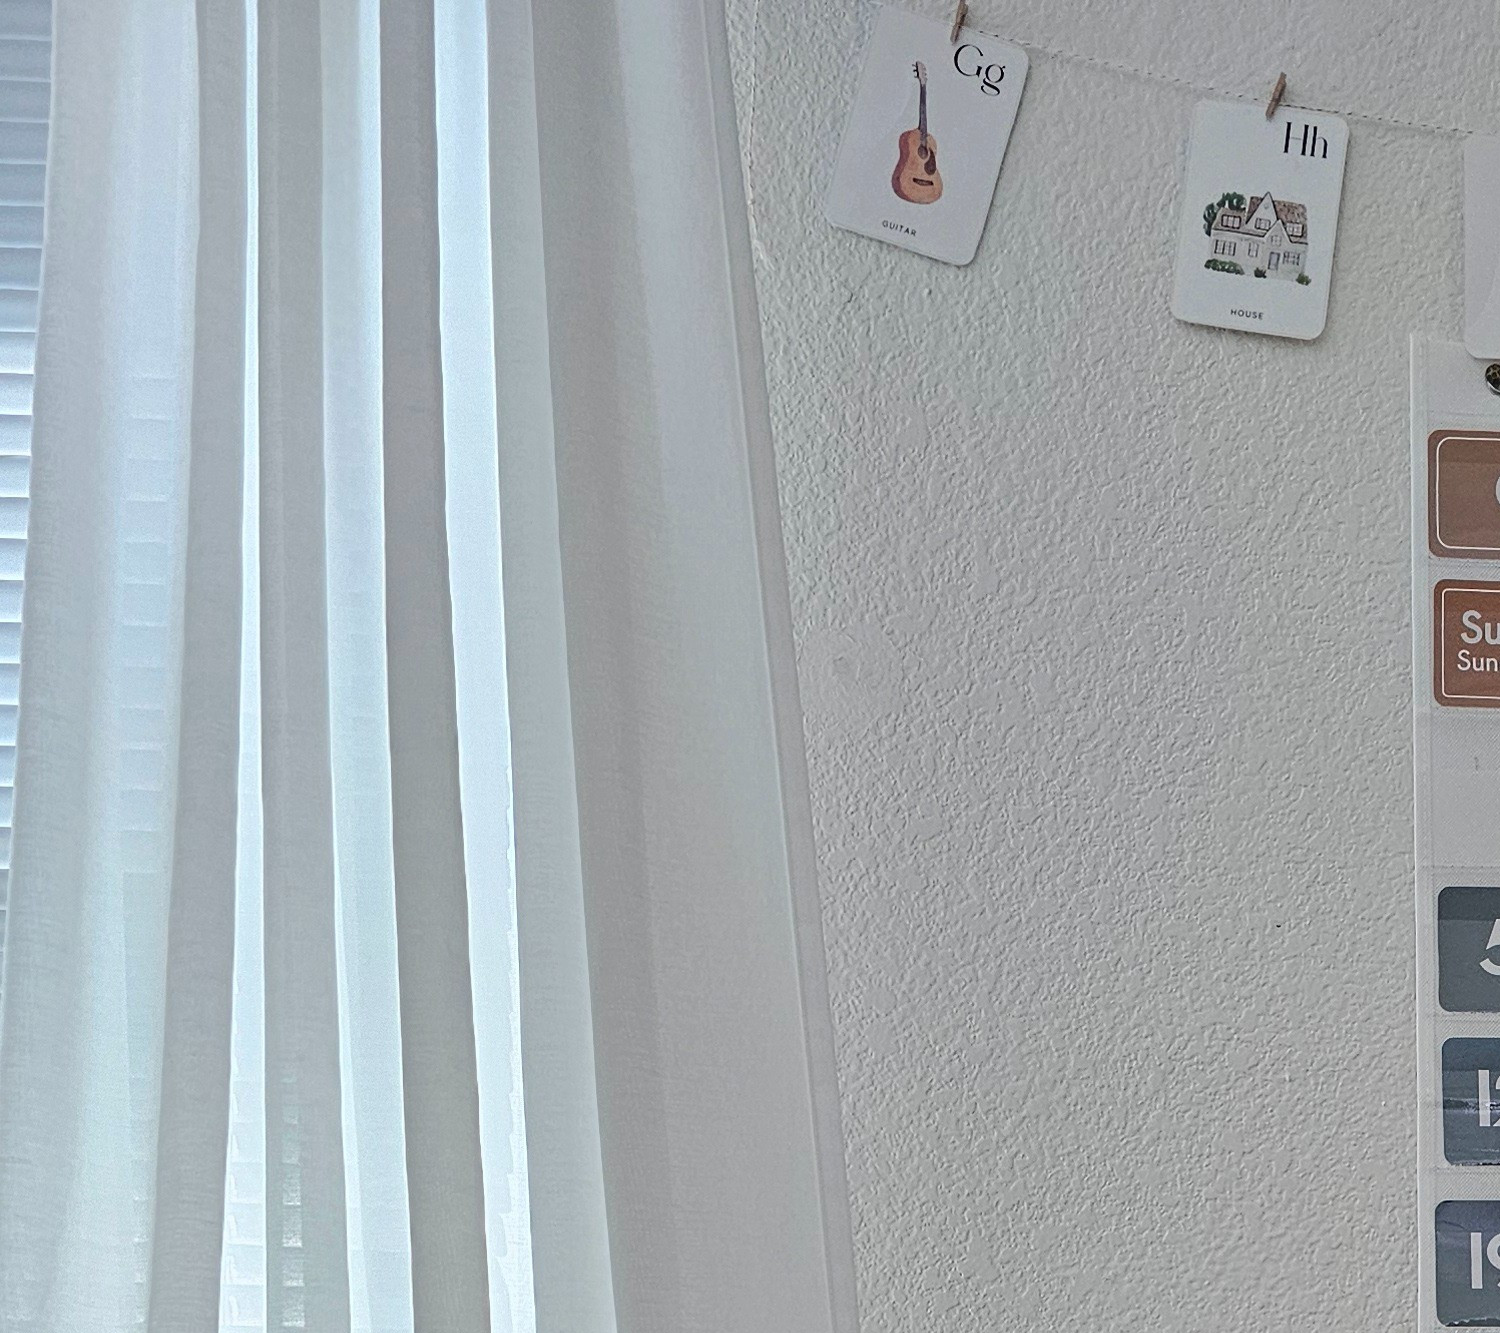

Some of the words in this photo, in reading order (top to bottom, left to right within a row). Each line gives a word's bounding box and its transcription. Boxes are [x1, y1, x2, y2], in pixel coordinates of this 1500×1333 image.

[953, 44, 1006, 96] Gg
[1283, 121, 1328, 159] Hh
[881, 219, 917, 237] GUITAR
[1230, 308, 1264, 320] HOUSE
